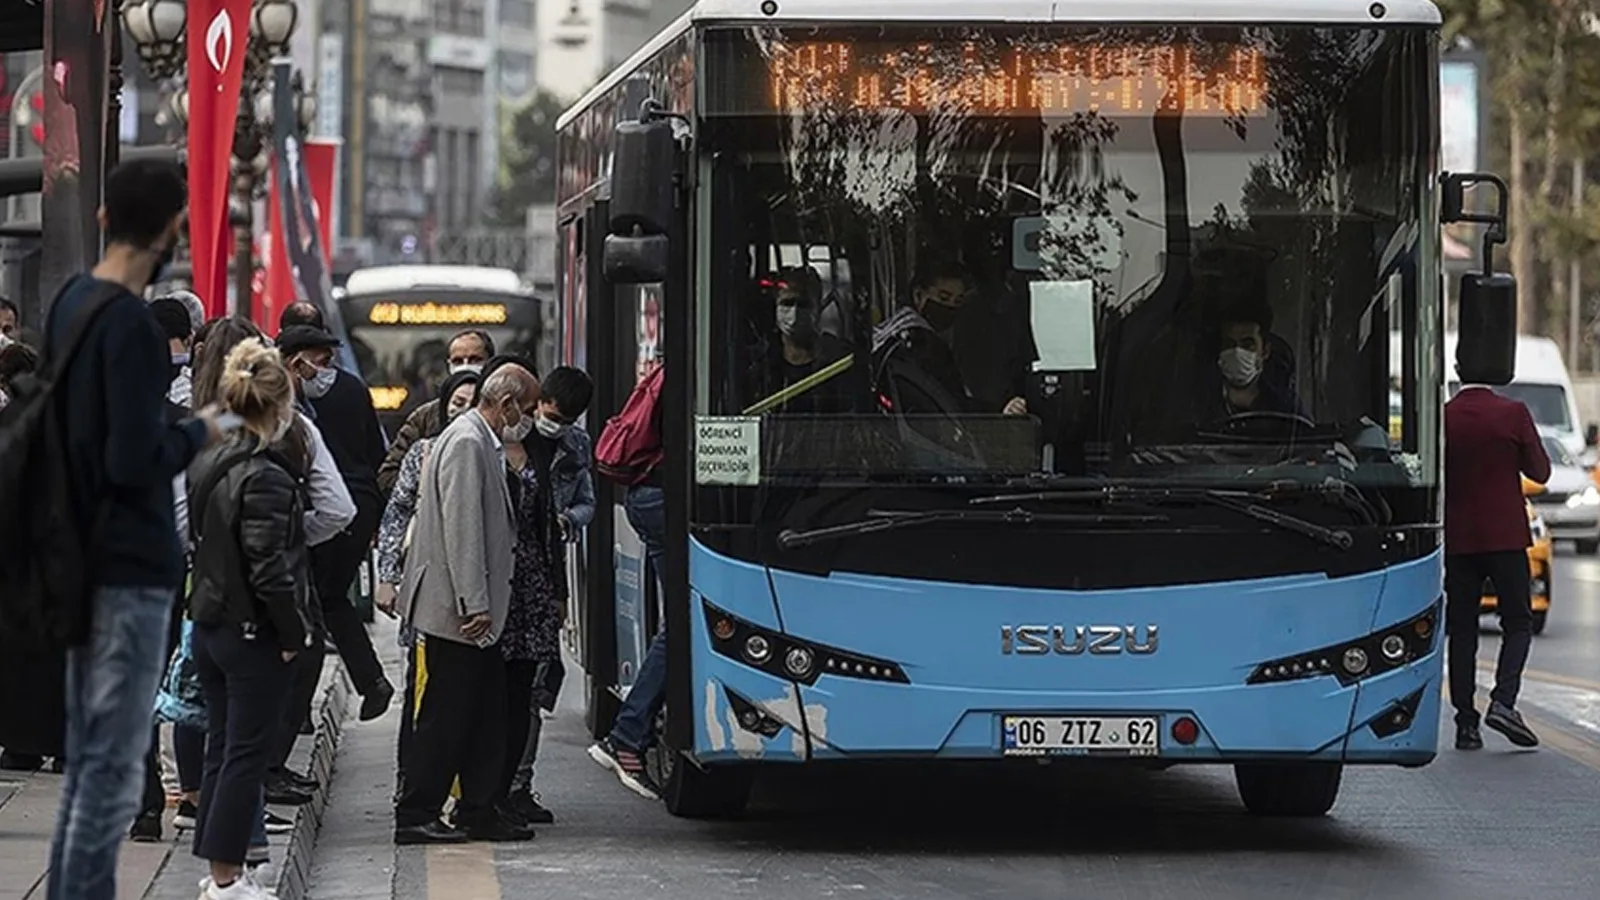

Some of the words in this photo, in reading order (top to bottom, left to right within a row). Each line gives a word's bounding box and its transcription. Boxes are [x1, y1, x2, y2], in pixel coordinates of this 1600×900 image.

[1001, 624, 1159, 655] ISUZU
[1018, 720, 1046, 745] 06
[1061, 720, 1103, 745] ZTZ
[1127, 720, 1155, 745] 62
